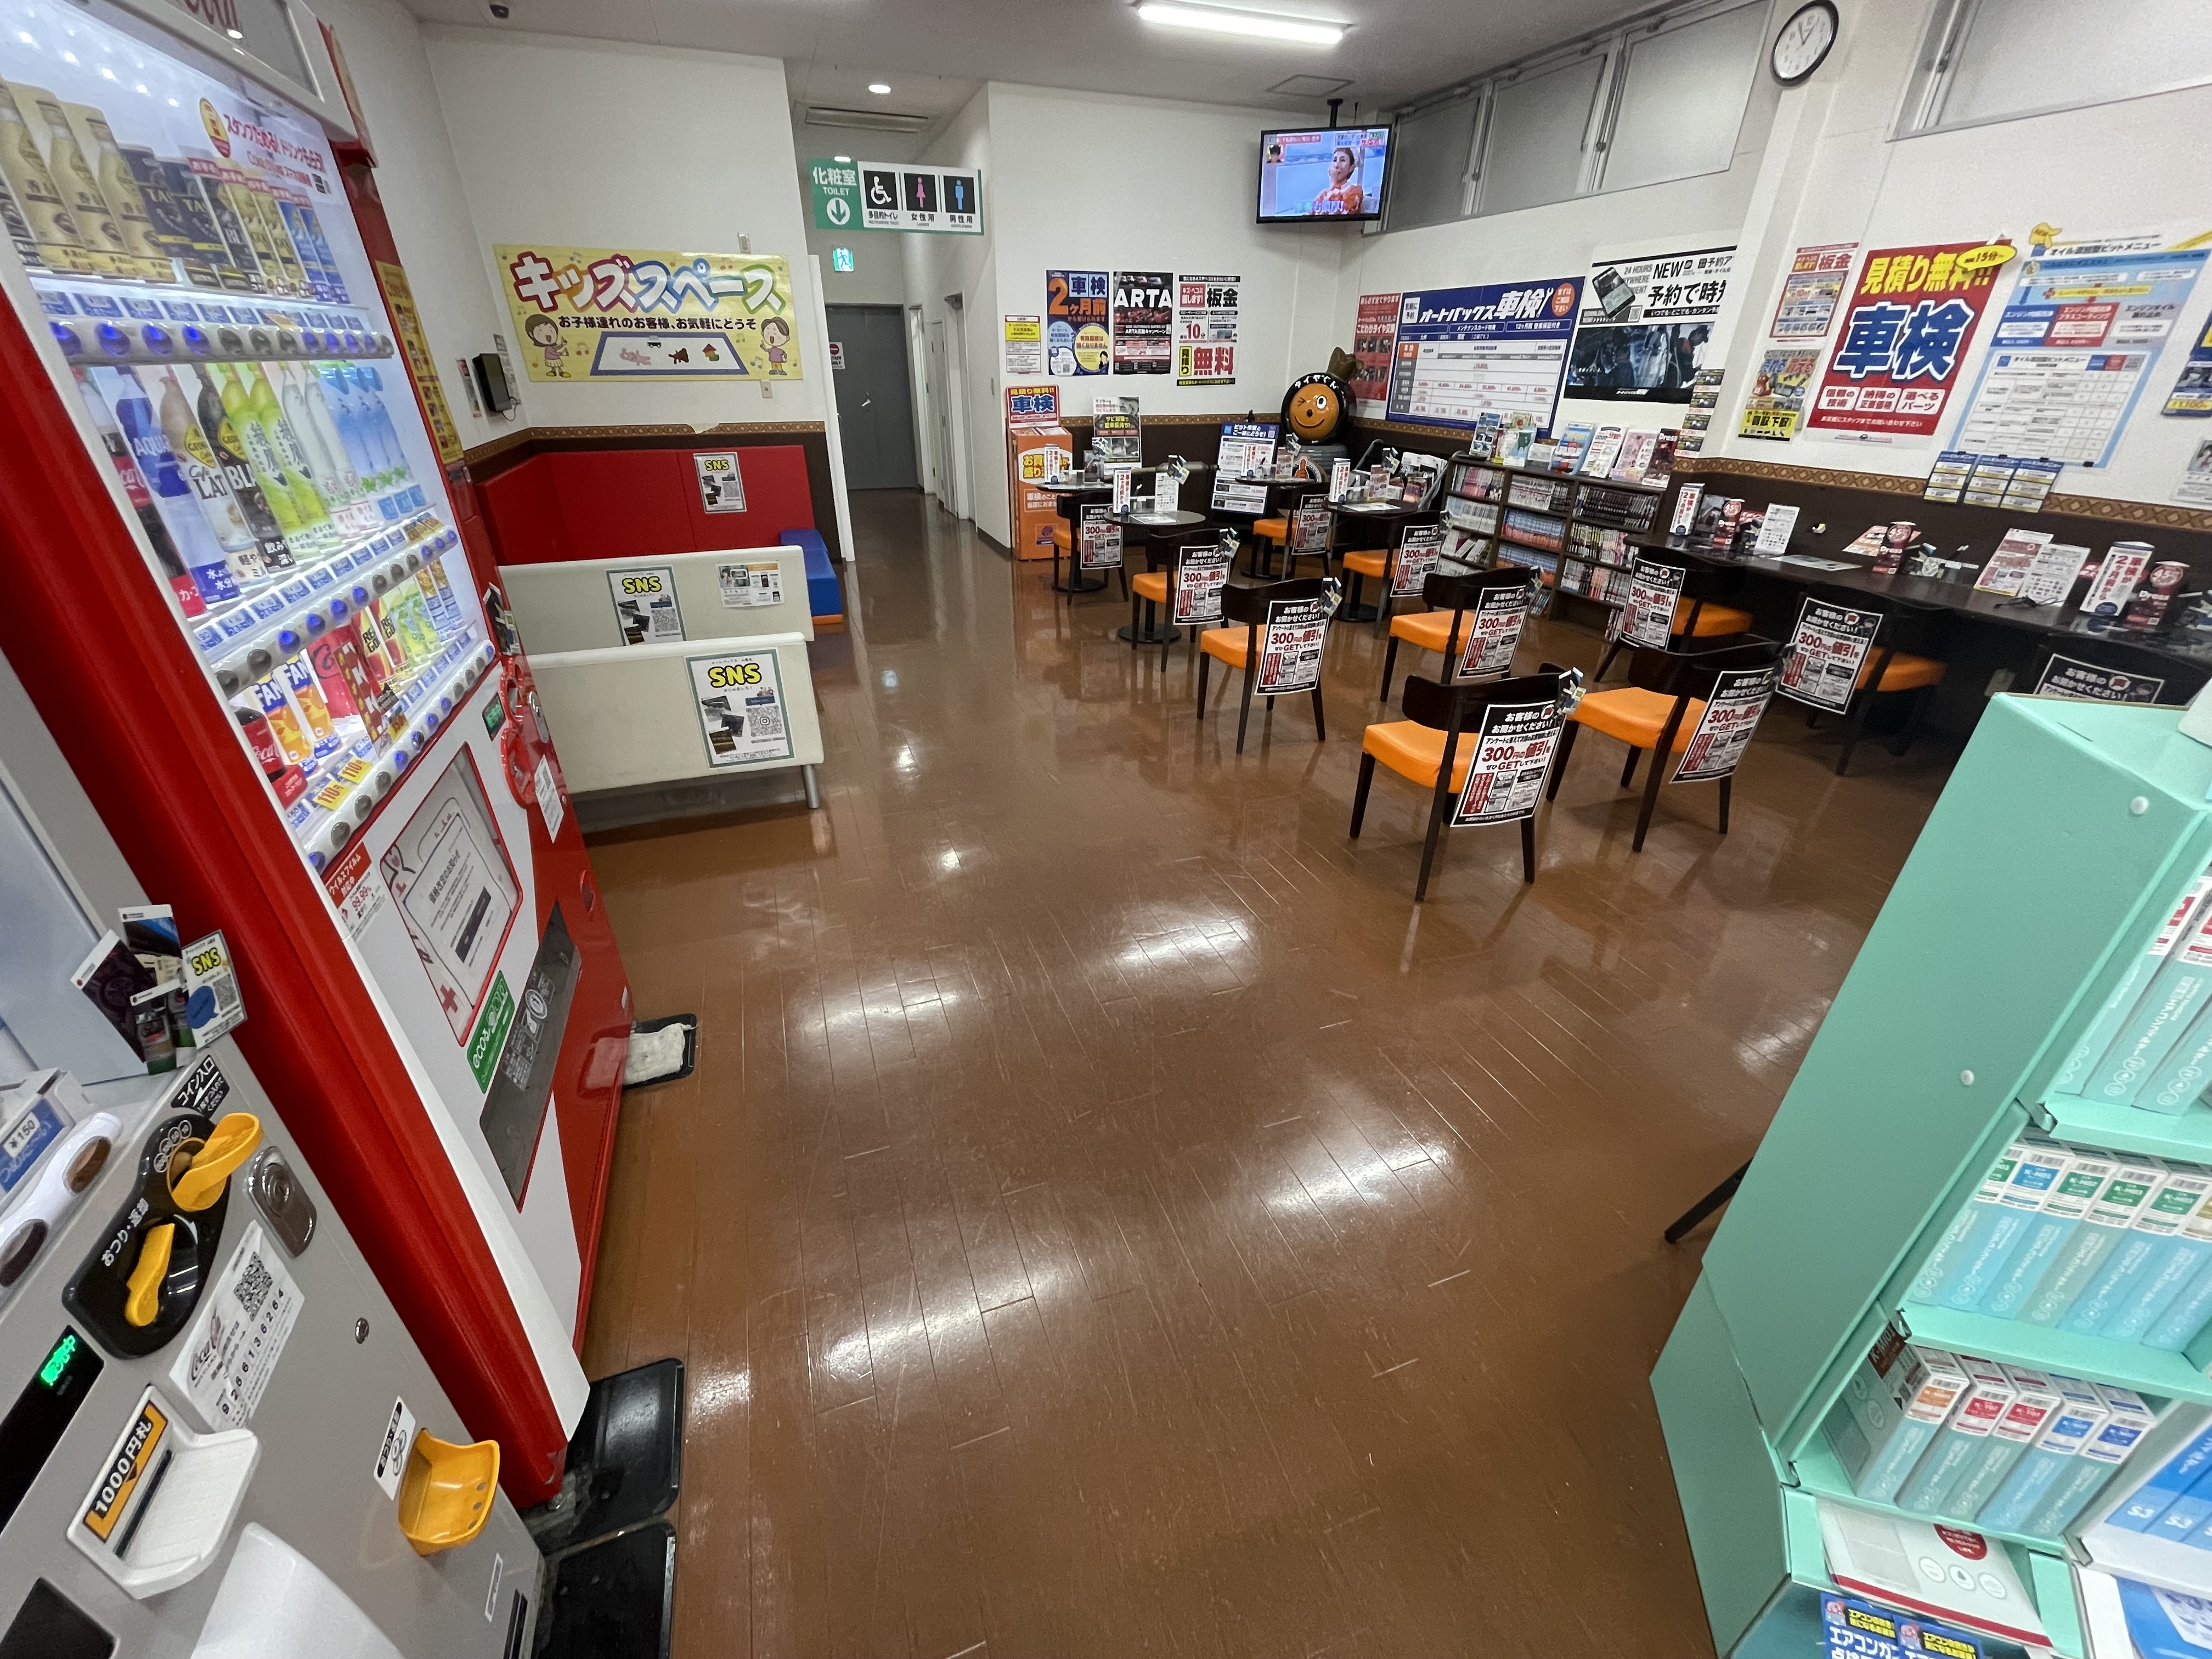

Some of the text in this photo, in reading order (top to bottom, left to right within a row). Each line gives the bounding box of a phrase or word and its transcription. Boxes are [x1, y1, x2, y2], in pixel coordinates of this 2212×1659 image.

[812, 167, 857, 186] 化粧室
[822, 187, 849, 196] TOILET
[868, 211, 898, 220] 多目的トイレ
[911, 213, 935, 222] 女性用
[950, 215, 973, 223] 男性用
[1633, 264, 1652, 274] HOURS
[1652, 261, 1684, 279] NEW
[1819, 253, 1852, 270] 板金
[510, 251, 786, 314] キッズスペース
[1071, 276, 1106, 295] 車検
[1048, 277, 1106, 315] 2ヶ月前
[1114, 288, 1172, 308] ARTA
[1207, 288, 1238, 308] 板金
[558, 315, 757, 330] お子様連れのお客様、お気軽にどうぞ
[1834, 299, 1974, 380] 車検
[1194, 347, 1234, 375] 無料
[1011, 394, 1054, 413] 車検
[1827, 399, 1848, 407] 技術
[1864, 390, 1895, 399] 納得の
[1905, 391, 1939, 400] 選べる
[704, 459, 730, 471] SNS
[622, 576, 662, 594] SNS
[1276, 613, 1320, 623] お聞かせください!
[1806, 615, 1858, 633] お聞かせください!
[708, 663, 762, 688] SNS
[2051, 675, 2128, 701] お聞かせください!
[1491, 719, 1553, 733] お聞かせください!
[1505, 712, 1539, 722] お客様の
[342, 759, 366, 778] 110円
[1486, 757, 1546, 770] ぜひGETして下さい!
[318, 784, 345, 804] 110円
[329, 853, 362, 895] ウイルスフィルム
[191, 947, 221, 976] SNS
[178, 1057, 216, 1106] コイン入口
[207, 1090, 224, 1113] ください
[220, 1288, 284, 1415] 9266136264
[95, 1415, 153, 1513] 1000円札
